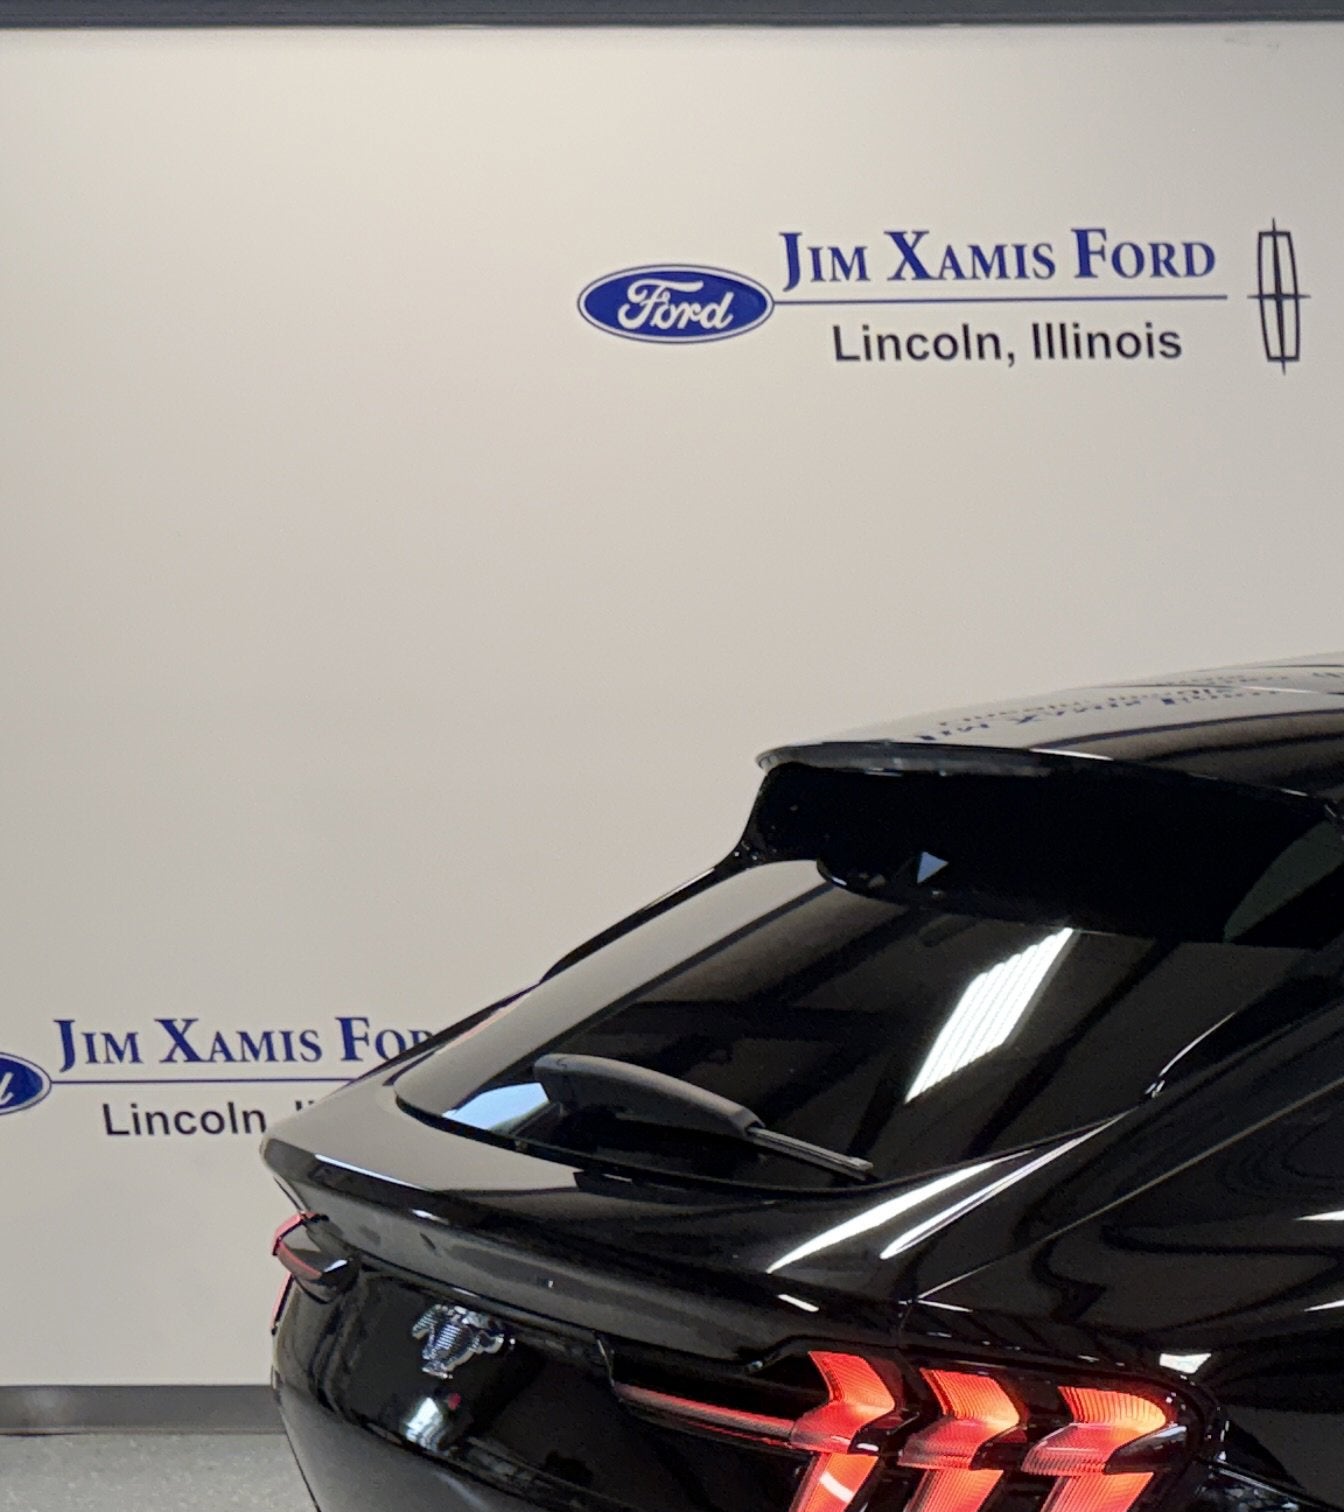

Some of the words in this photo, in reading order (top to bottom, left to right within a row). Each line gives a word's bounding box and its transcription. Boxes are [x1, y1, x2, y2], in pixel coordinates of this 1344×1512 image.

[780, 232, 870, 293] JIM
[883, 230, 1056, 281] XAMIS
[1070, 228, 1216, 279] FORD
[616, 279, 735, 331] Ford
[832, 324, 1016, 368] Lincoln,
[1032, 322, 1183, 361] Illinois
[54, 1018, 143, 1073] JIM
[154, 1018, 323, 1063] XAMIS
[102, 1101, 267, 1136] Lincoln
